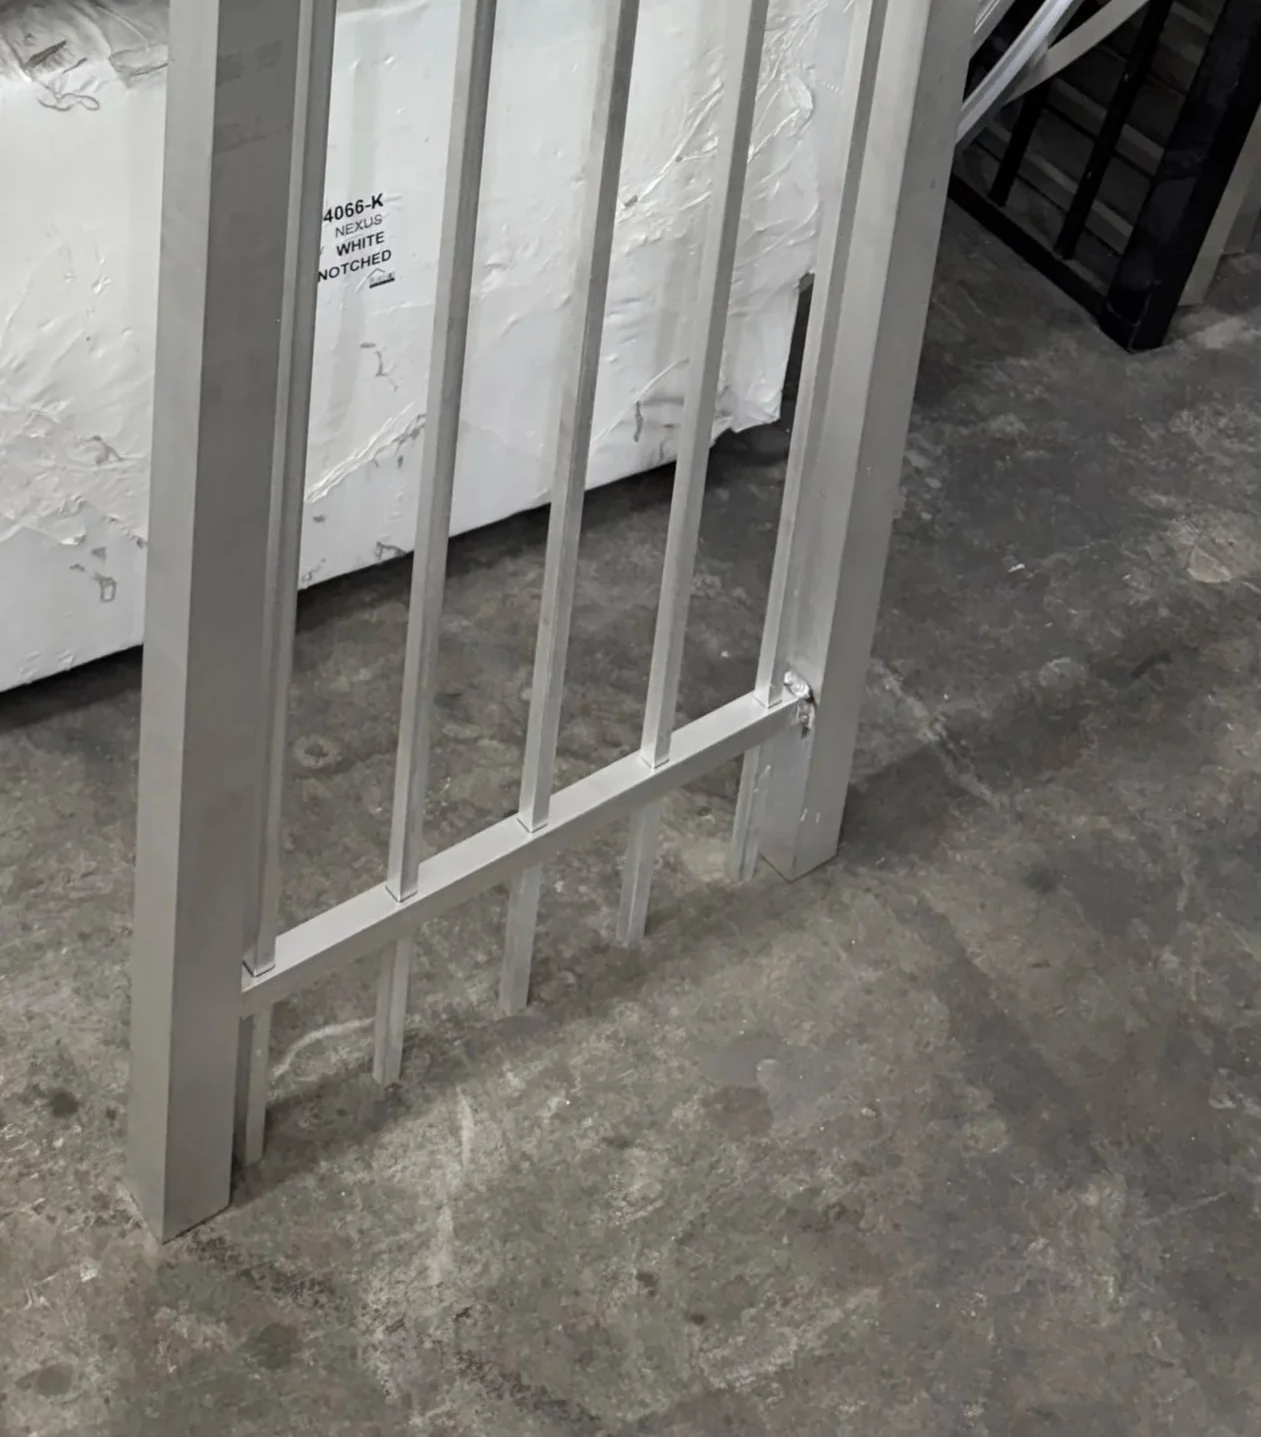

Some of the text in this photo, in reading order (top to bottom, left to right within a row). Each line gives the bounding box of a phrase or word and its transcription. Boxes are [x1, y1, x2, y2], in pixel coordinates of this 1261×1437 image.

[323, 193, 383, 222] 4066-K
[335, 214, 382, 238] NEXUS
[337, 231, 384, 256] WHITE
[318, 250, 391, 282] NOTCHED
